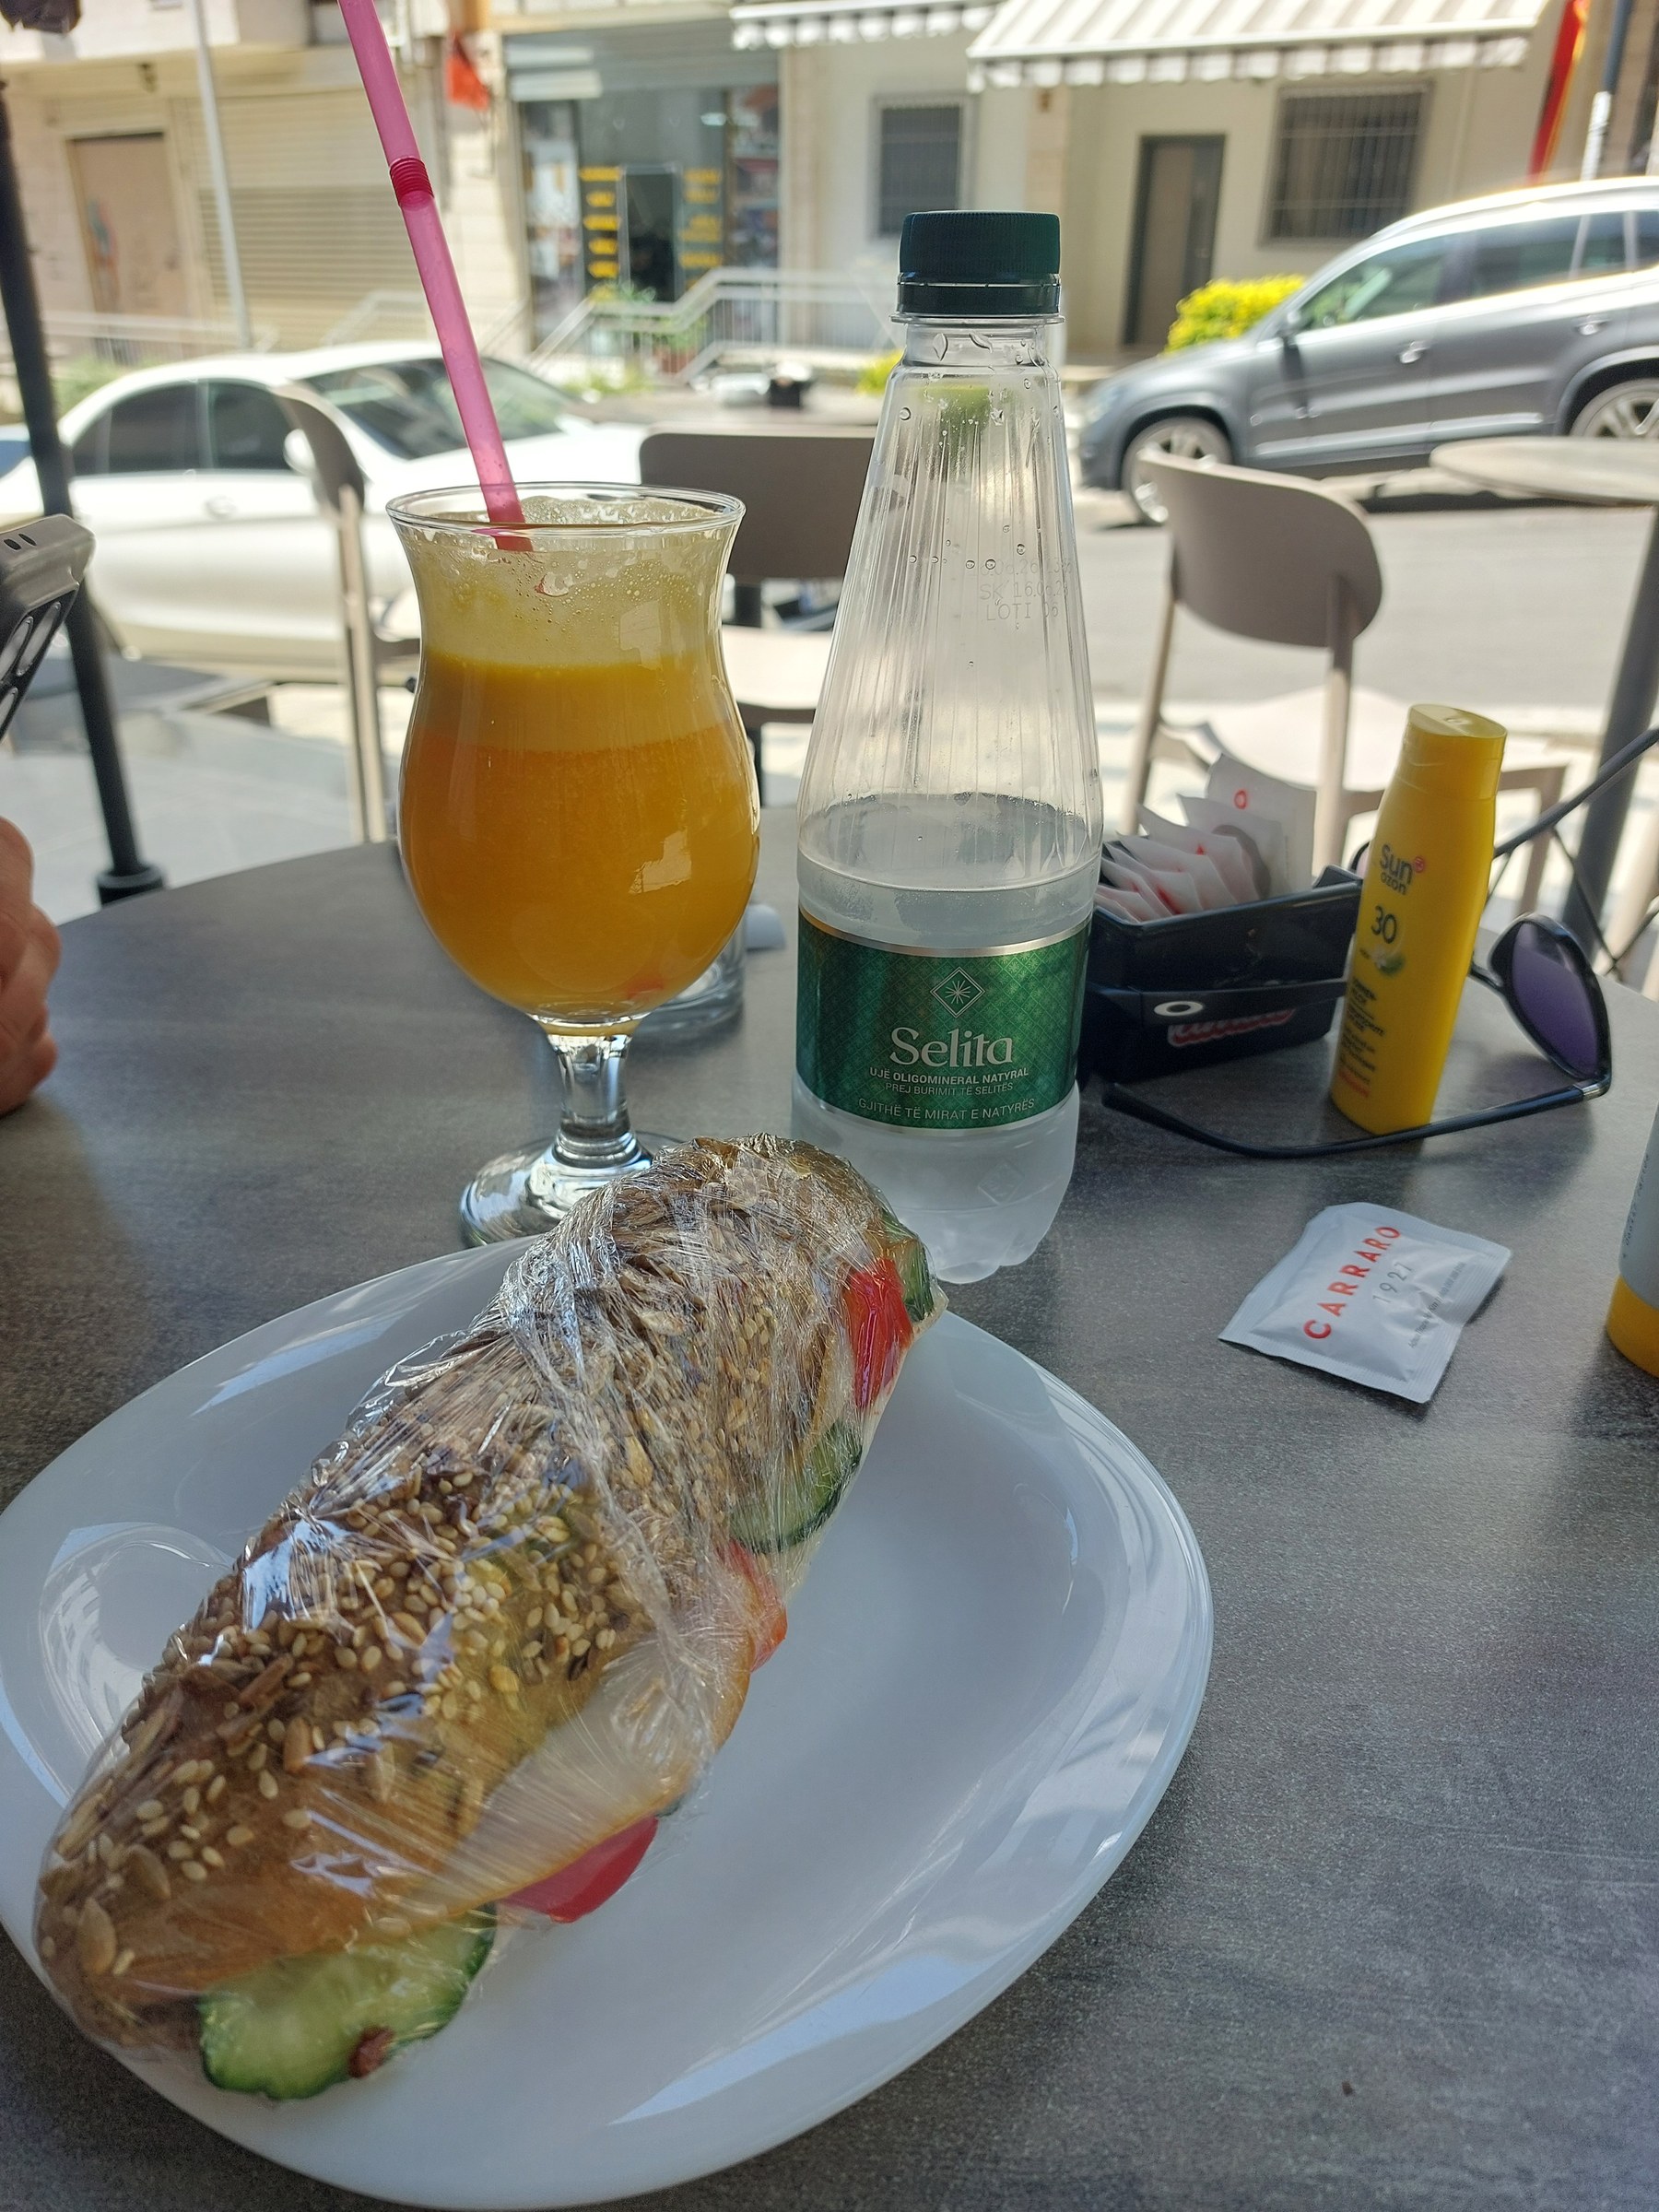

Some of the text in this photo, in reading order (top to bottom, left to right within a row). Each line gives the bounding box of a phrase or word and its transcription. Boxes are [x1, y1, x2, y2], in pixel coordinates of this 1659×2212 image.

[986, 602, 1031, 621] LOTI
[1380, 843, 1413, 886] Sun
[1380, 871, 1407, 896] ozon
[1371, 904, 1397, 945] 30
[889, 1027, 1013, 1067] Selita
[869, 1066, 1030, 1085] UJË OLIGOMINERAL NATYRAL
[885, 1082, 1014, 1096] PREJ BURIMIT TË SELITËS
[858, 1098, 1035, 1121] GJITHË TË MIRAT E NATYRËS
[1303, 1226, 1401, 1339] CARRARO
[1372, 1261, 1413, 1303] 1921
